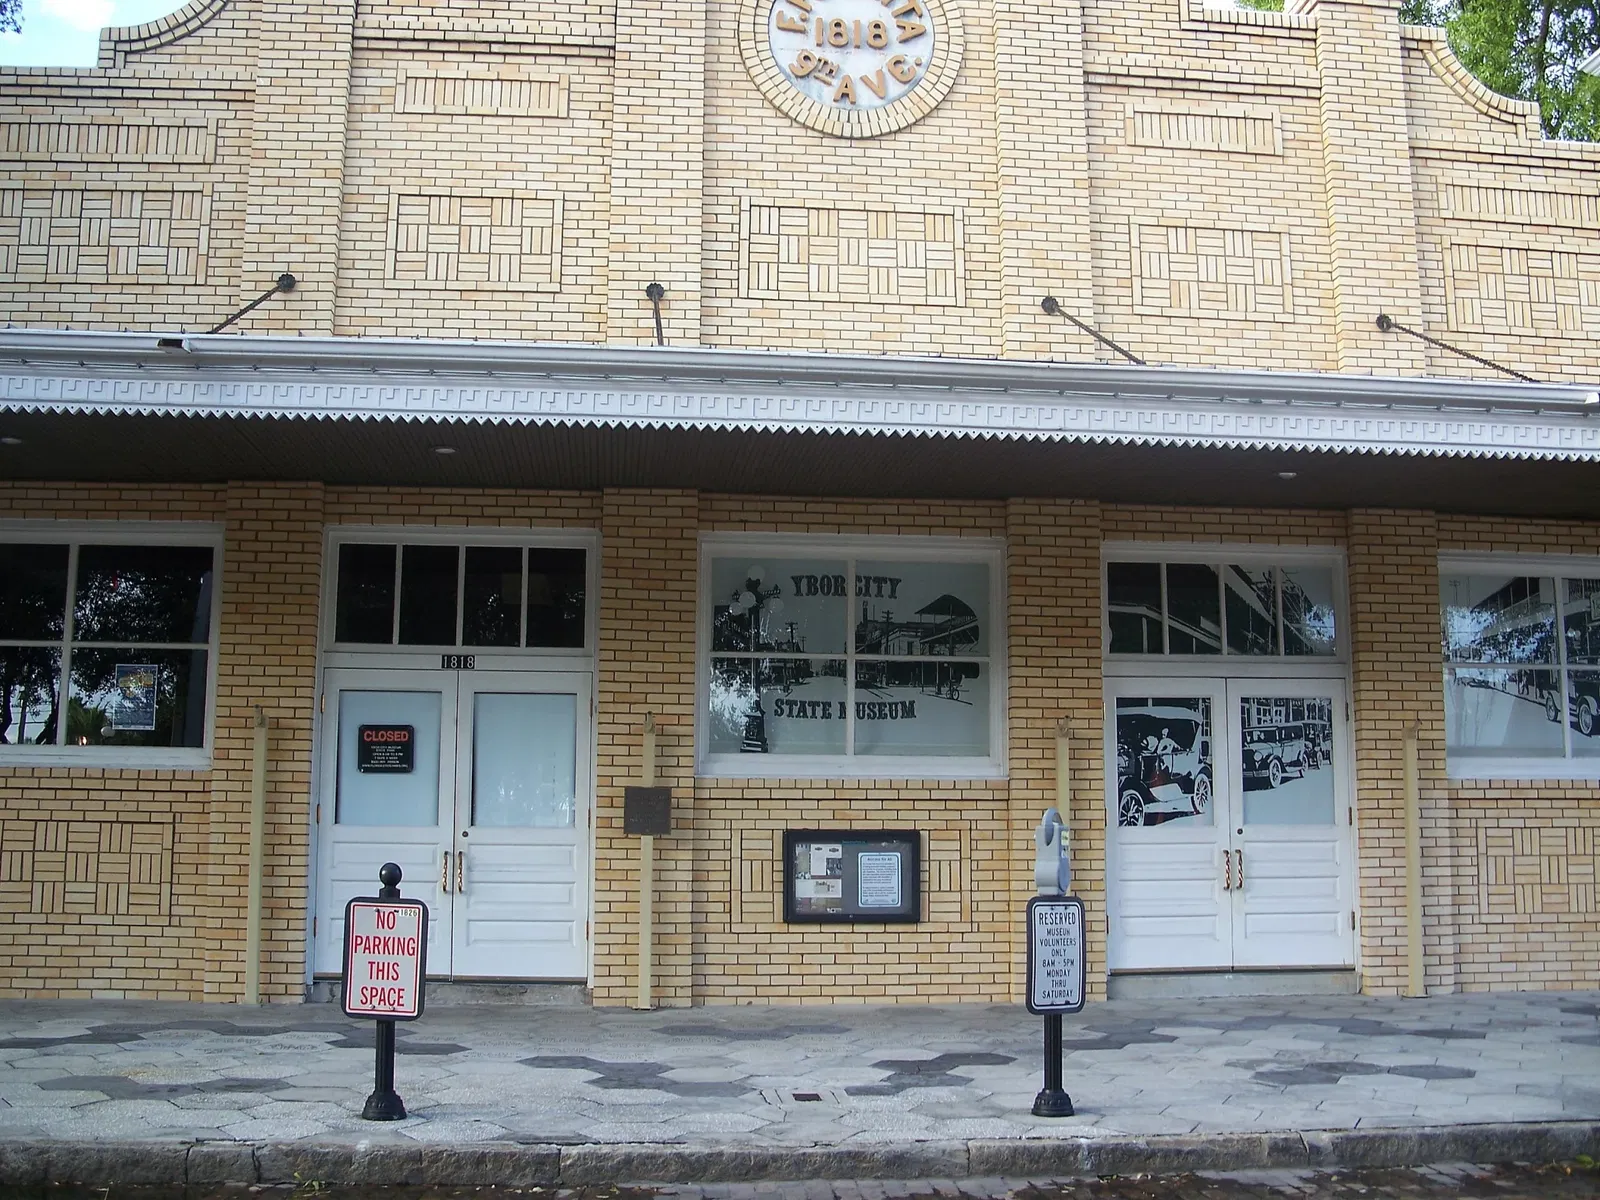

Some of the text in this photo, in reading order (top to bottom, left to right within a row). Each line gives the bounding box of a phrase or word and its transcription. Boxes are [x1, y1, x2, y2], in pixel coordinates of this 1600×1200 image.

[815, 17, 889, 49] 1818
[791, 575, 902, 599] YBOR CITY
[444, 656, 474, 669] 1818
[774, 698, 832, 719] STATE
[363, 730, 409, 742] CLOSED
[401, 908, 418, 917] 1826
[376, 911, 396, 930] NO
[1039, 912, 1076, 926] RESERVED
[1047, 928, 1071, 936] MUSEUM
[354, 935, 416, 957] PARKING
[1039, 938, 1077, 947] VOLUNTEERS
[1051, 949, 1067, 957] ONLY
[1042, 959, 1056, 967] 8AM
[1063, 958, 1075, 967] 5PM
[368, 961, 399, 981] THIS
[1046, 969, 1071, 978] MONDAY
[1051, 979, 1067, 988] THRU
[360, 986, 405, 1007] SPACE
[1042, 989, 1074, 999] SATURDAY
